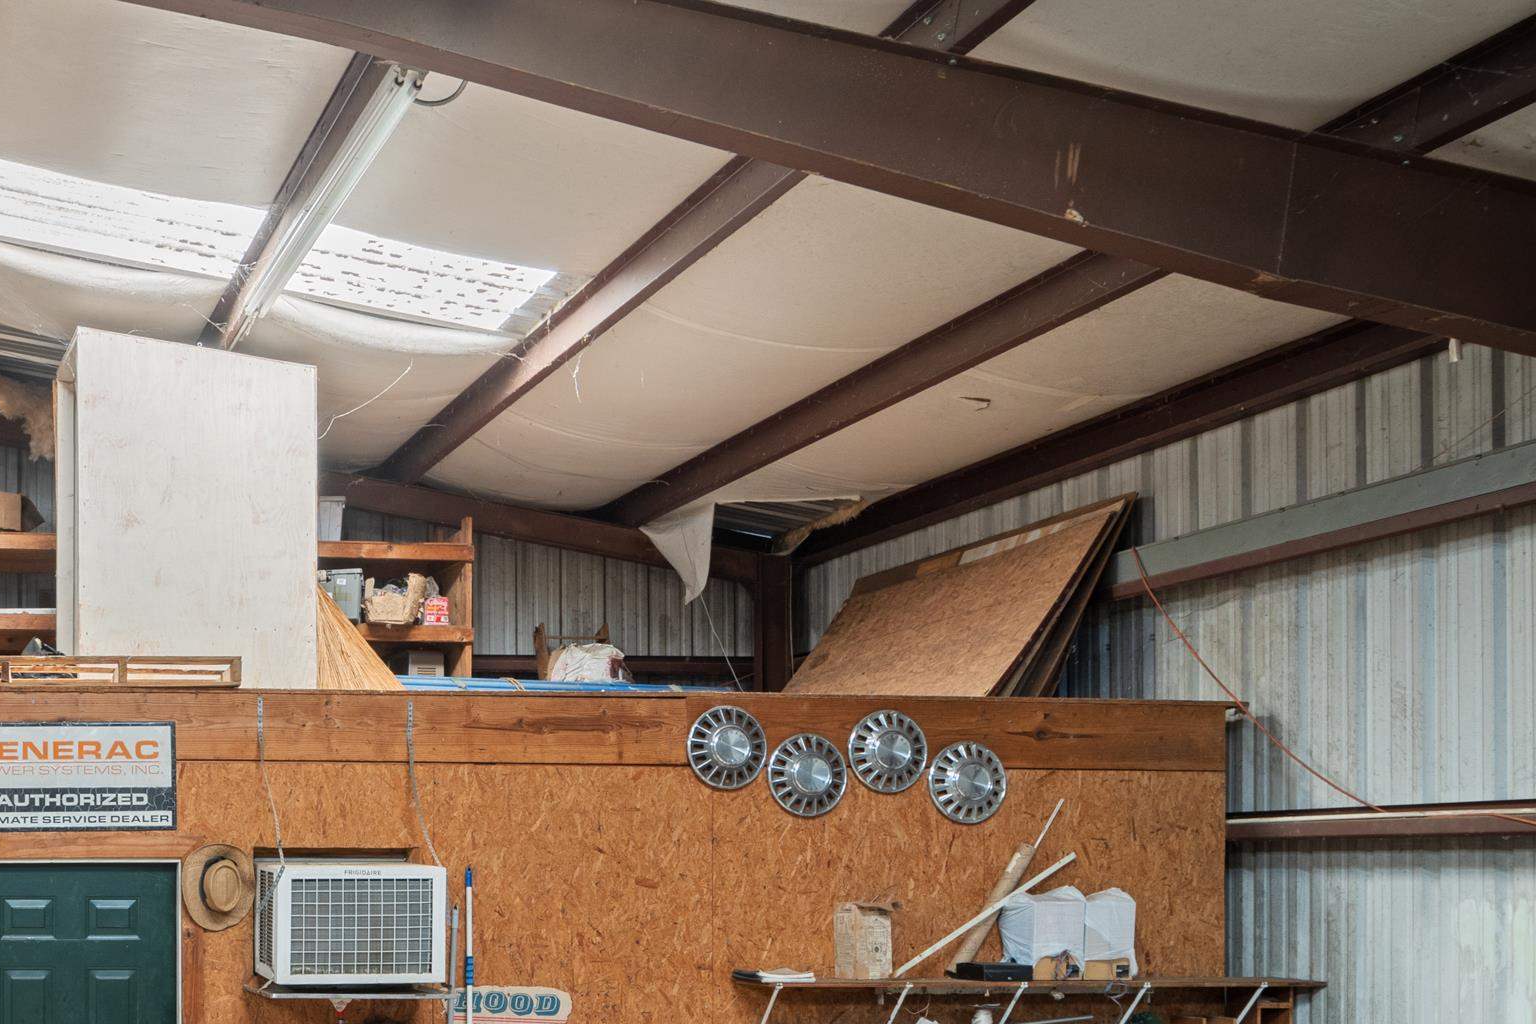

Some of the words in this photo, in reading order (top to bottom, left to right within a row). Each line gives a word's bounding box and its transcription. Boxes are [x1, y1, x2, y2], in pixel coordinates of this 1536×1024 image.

[131, 764, 164, 776] INC.
[42, 815, 107, 824] SERVICE
[110, 814, 170, 824] DEALER
